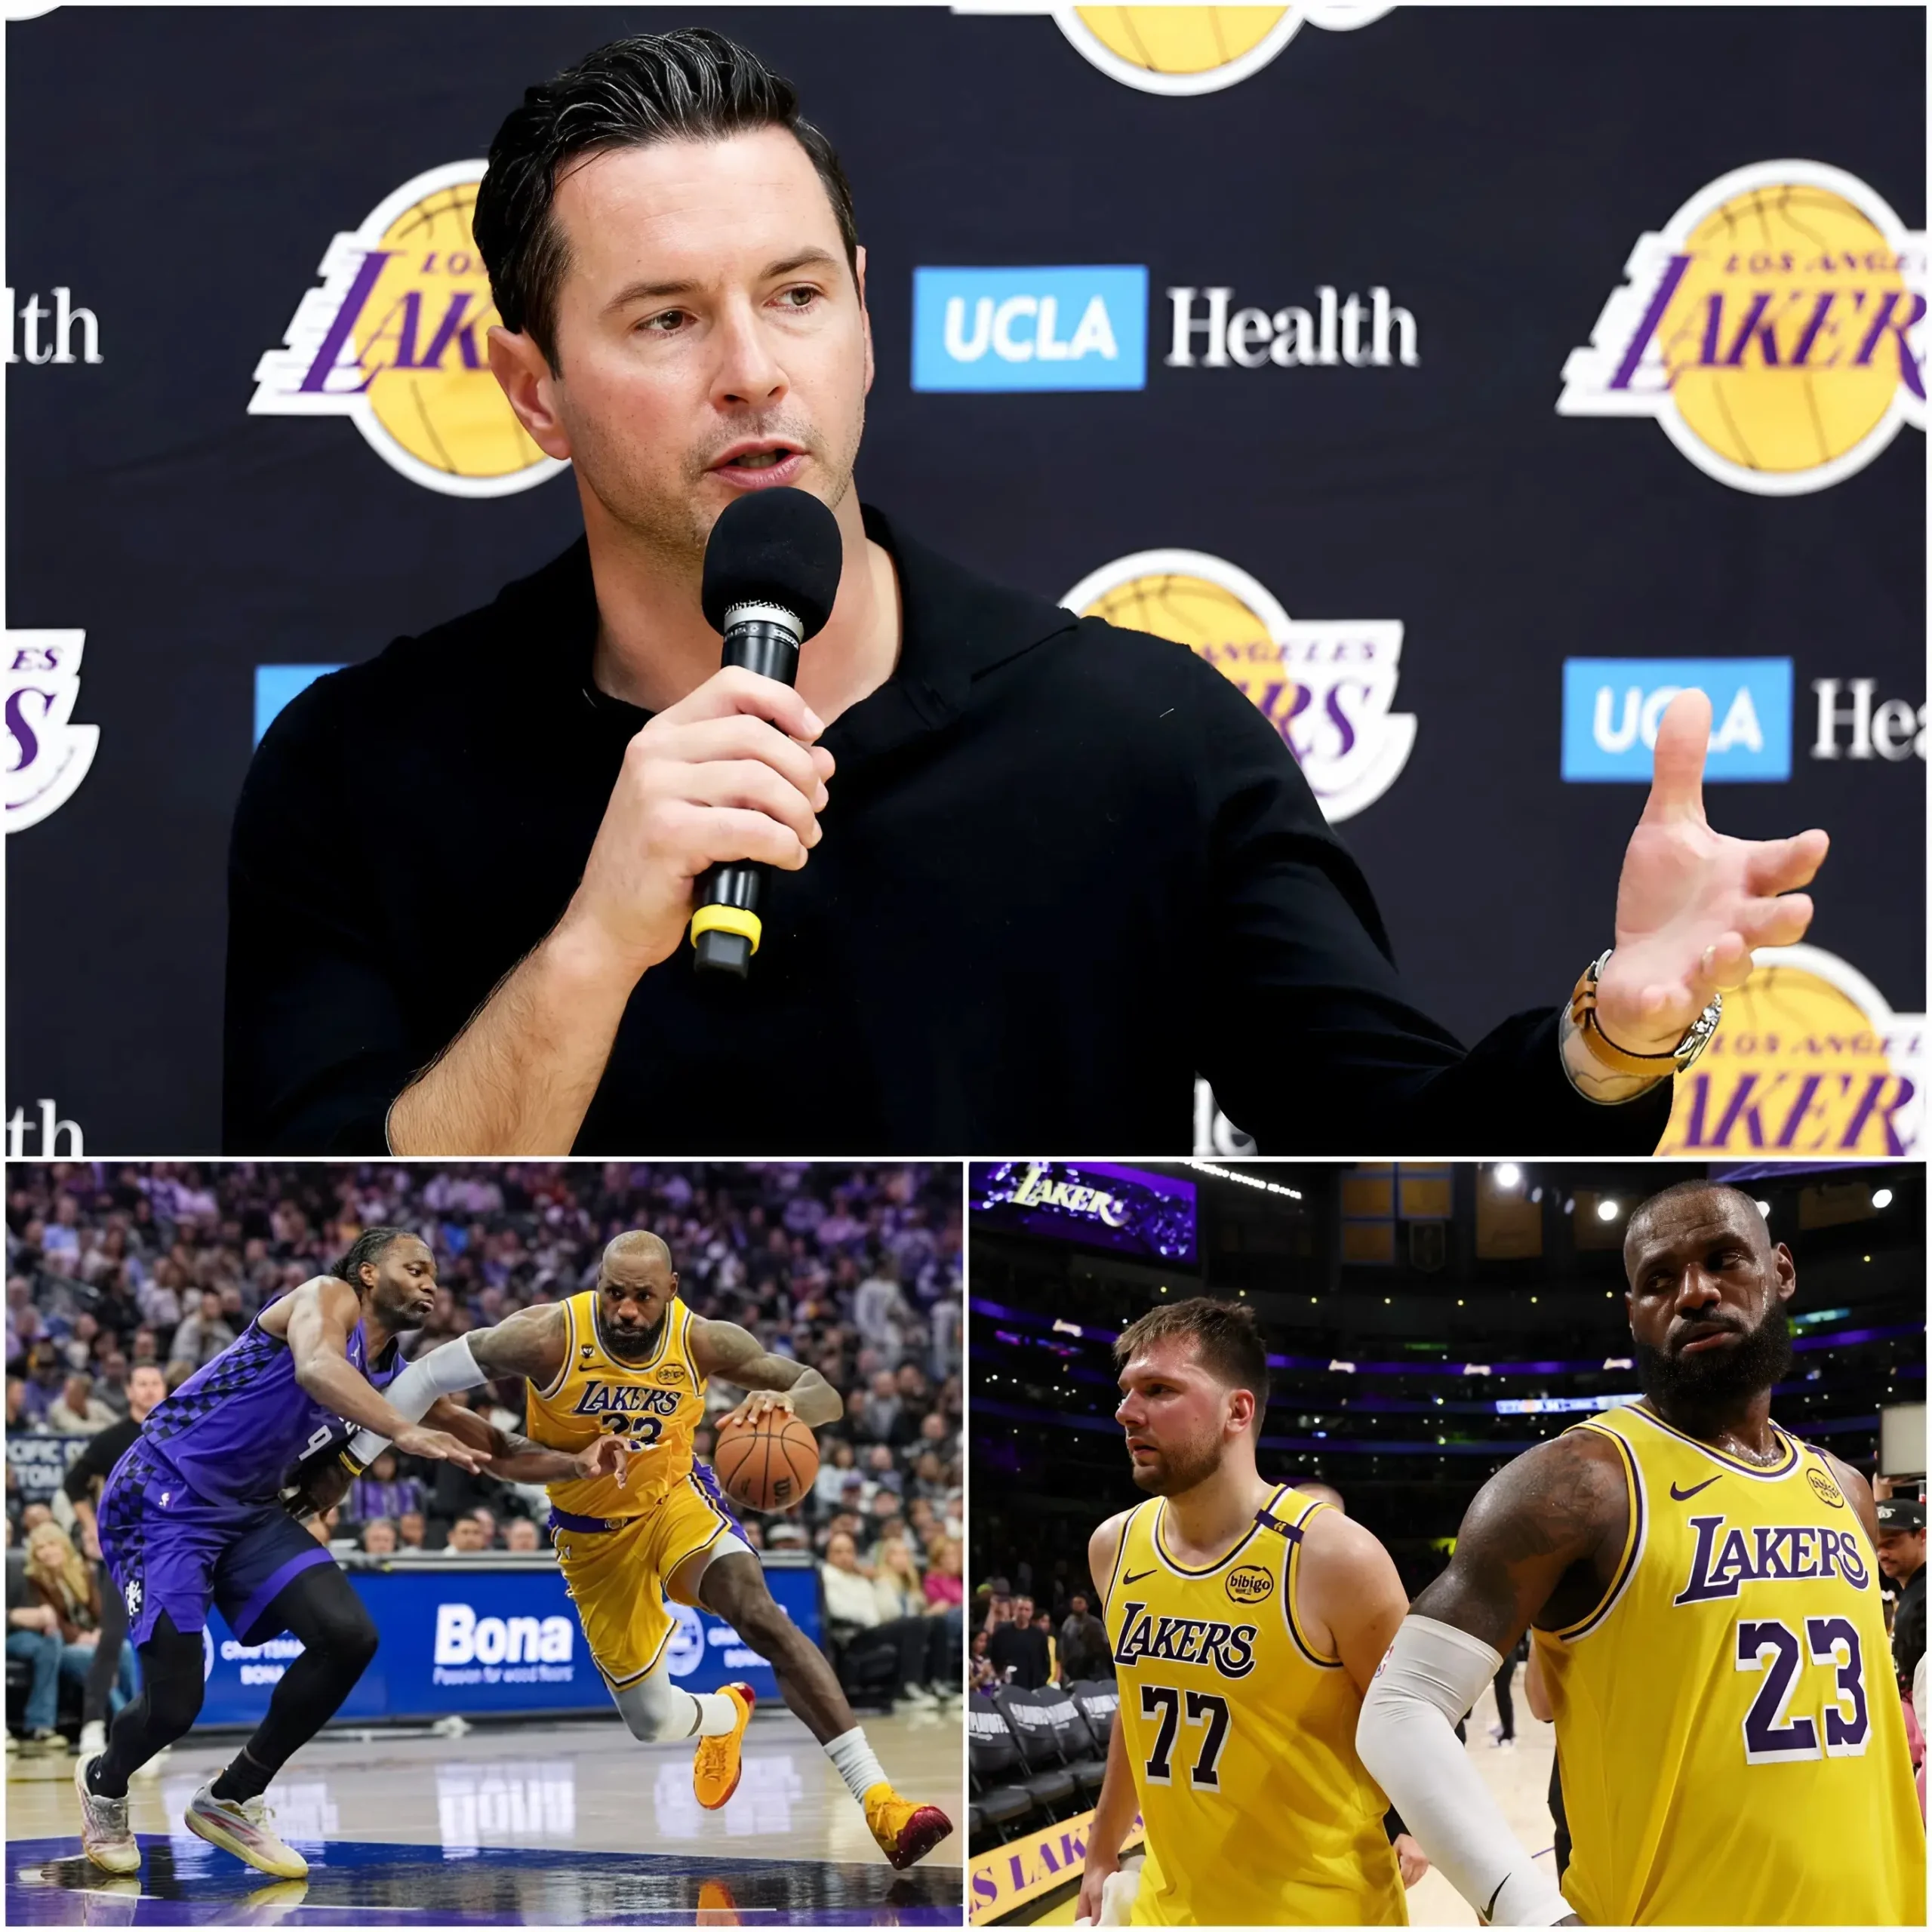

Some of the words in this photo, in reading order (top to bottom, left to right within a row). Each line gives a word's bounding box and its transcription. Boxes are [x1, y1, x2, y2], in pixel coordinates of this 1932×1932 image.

[1724, 253, 1794, 272] LOS
[294, 250, 492, 393] LAK
[943, 296, 1118, 362] UCLA
[1163, 285, 1420, 368] Health
[1709, 1032, 1780, 1054] LOS
[573, 1380, 683, 1417] LAKERS
[1229, 1574, 1271, 1594] bibigo
[1672, 1515, 1869, 1607] LAKERS
[434, 1603, 574, 1665] Bona
[1114, 1601, 1258, 1679] LAKERS
[1734, 1616, 1872, 1765] 23
[1140, 1684, 1232, 1793] 77
